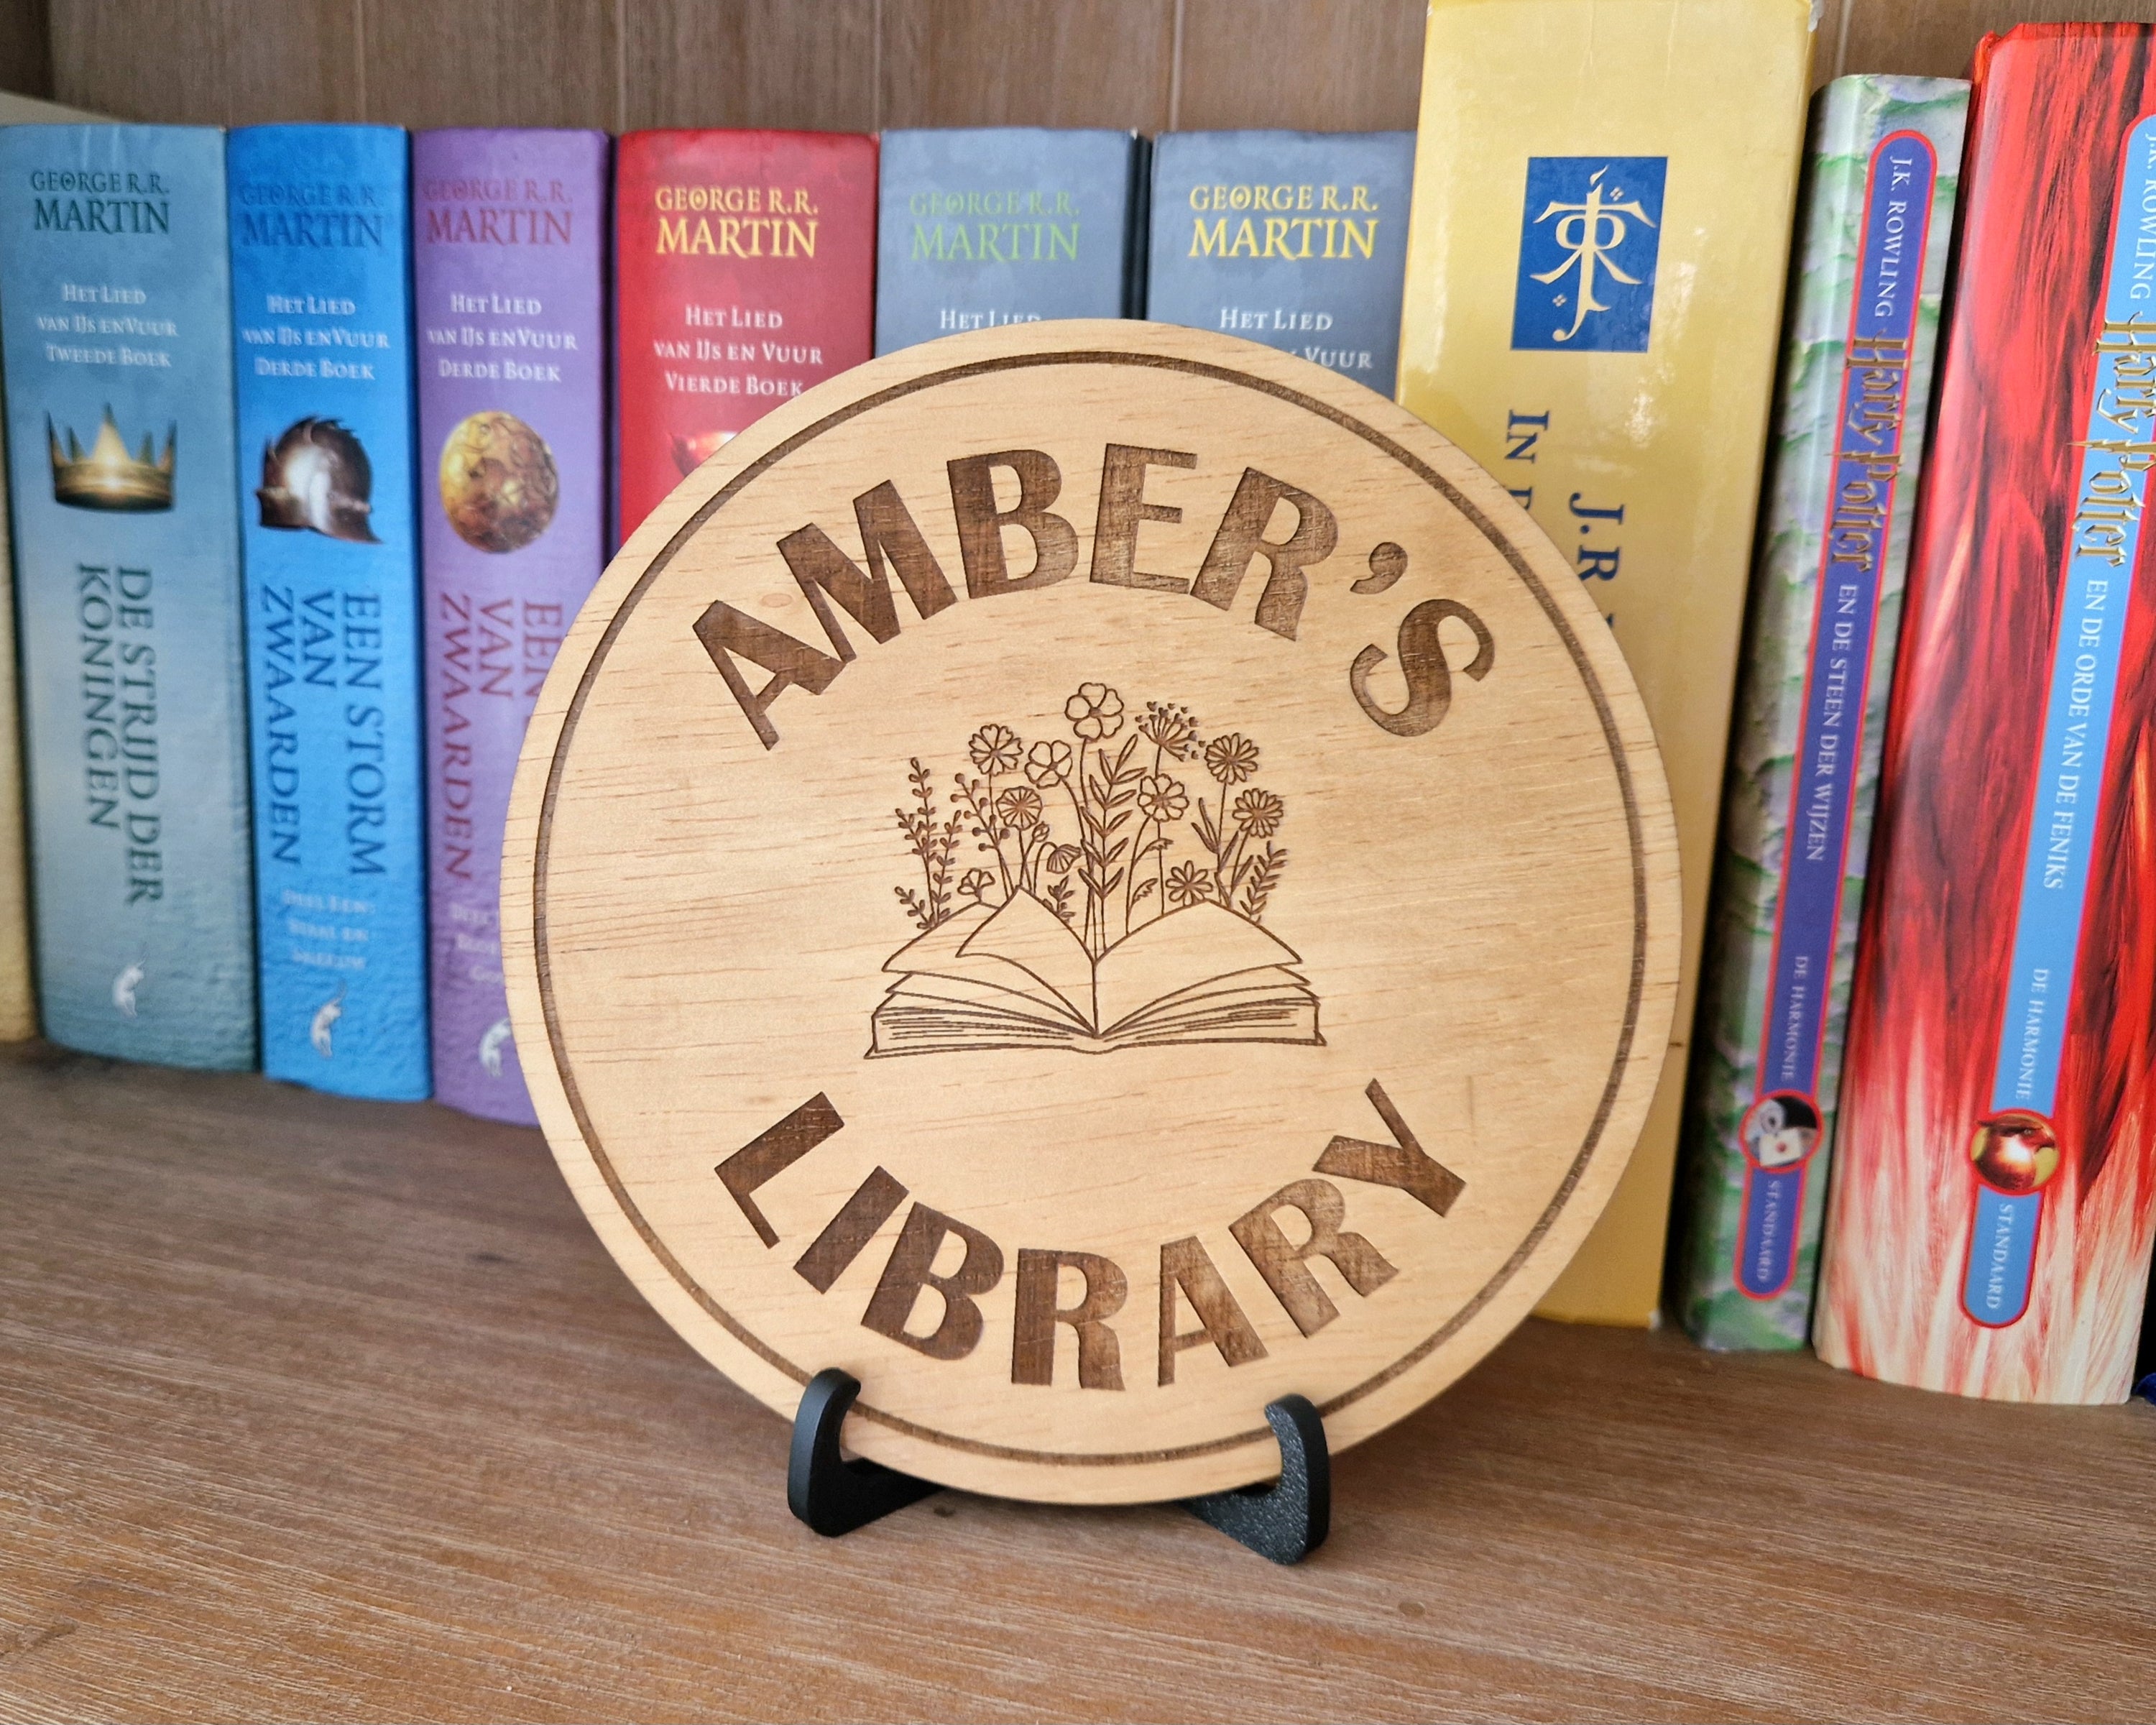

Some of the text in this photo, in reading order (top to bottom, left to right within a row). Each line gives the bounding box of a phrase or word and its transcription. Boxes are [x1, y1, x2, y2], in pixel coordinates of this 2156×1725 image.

[32, 171, 121, 193] GEORGE
[34, 198, 170, 234] MARTIN
[240, 183, 331, 206] GEORGE
[241, 212, 384, 247] MARTIN
[423, 178, 517, 201] GEORGE
[427, 208, 573, 246] MARTIN
[655, 187, 819, 215] GEORGE R.R.
[910, 190, 1079, 215] GEORGE R.R.
[1189, 185, 1378, 211] GEORGE R.R.
[656, 217, 819, 259] MARTIN
[911, 223, 1080, 262] MARTIN
[1189, 218, 1379, 260] MARTIN
[1874, 155, 1912, 318] J.K. ROWLING
[1504, 409, 1550, 464] IN
[1824, 328, 1909, 572] Harry Potter
[2066, 310, 2156, 568] Harry Potter
[302, 590, 336, 689] VAN
[692, 443, 1495, 750] AMBER'S
[78, 564, 120, 829] KONINGEN
[478, 598, 513, 699] VAN
[118, 566, 164, 905] DE STRIJD DER
[262, 584, 301, 865] ZWAARDEN
[344, 592, 387, 875] EEN STORM
[441, 592, 472, 880] ZWAARDEN
[1806, 584, 1858, 862] EN DE STEEN DER WIJZEN
[2043, 579, 2108, 891] EN DE ORDE VAN DE FENIKS
[1782, 955, 1809, 1080] DE HARMONIE
[2016, 967, 2050, 1100] DE HARMONIE
[714, 1077, 1466, 1392] LIBRARY
[1757, 1180, 1781, 1283] STANDAARD
[1986, 1203, 2013, 1310] STANDAARD
